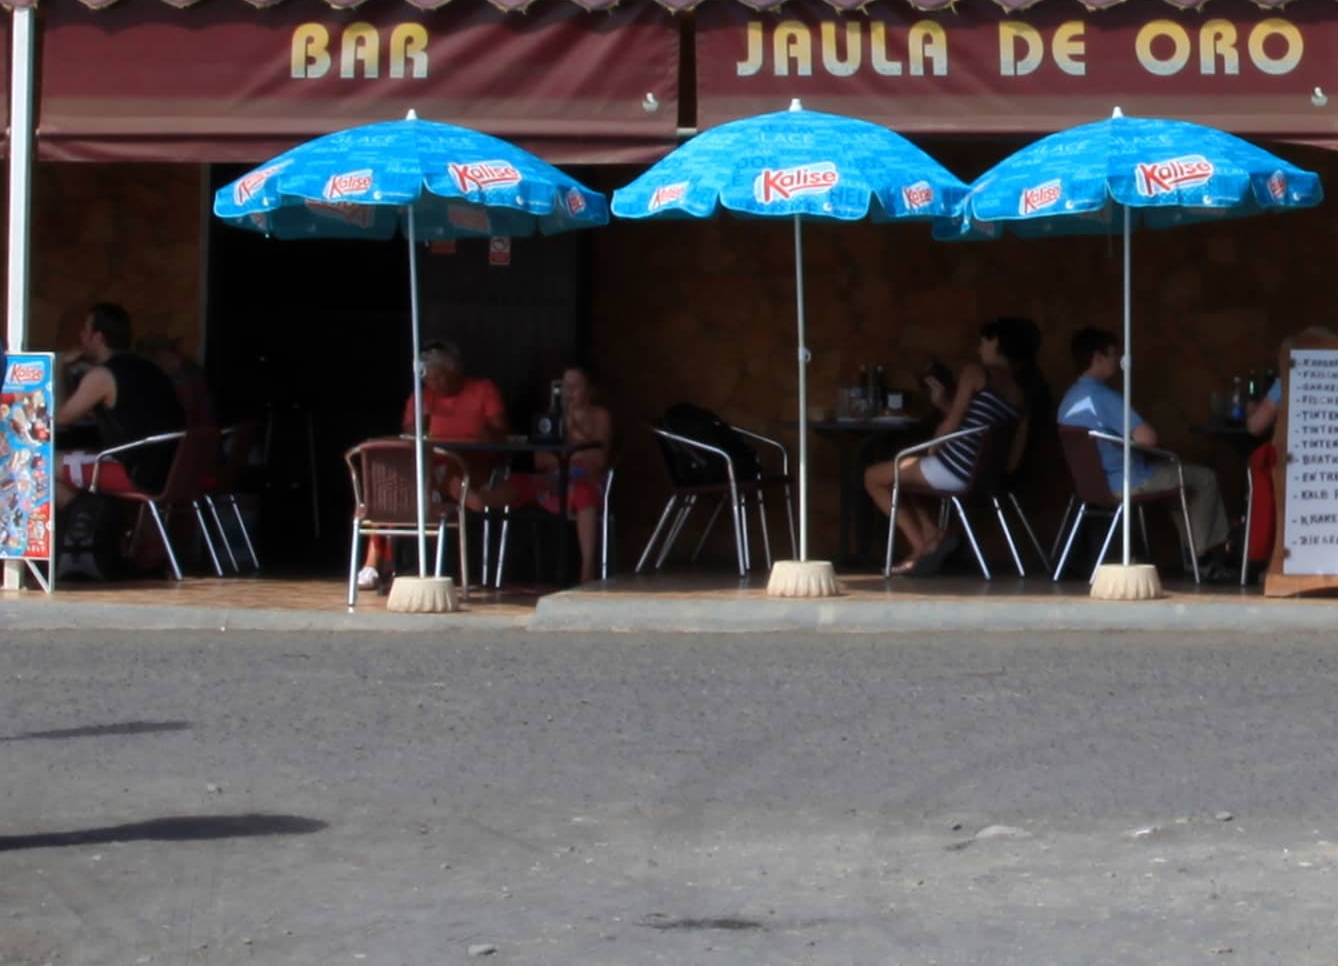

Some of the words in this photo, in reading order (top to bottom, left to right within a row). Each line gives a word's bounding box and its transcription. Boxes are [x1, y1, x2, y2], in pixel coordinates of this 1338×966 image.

[290, 22, 429, 79] BAR
[737, 20, 948, 76] JAULA
[999, 20, 1086, 77] DE
[1135, 18, 1304, 77] ORO
[452, 164, 518, 192] Kalise
[764, 168, 836, 202] Kalise
[1141, 162, 1211, 194] Kalise
